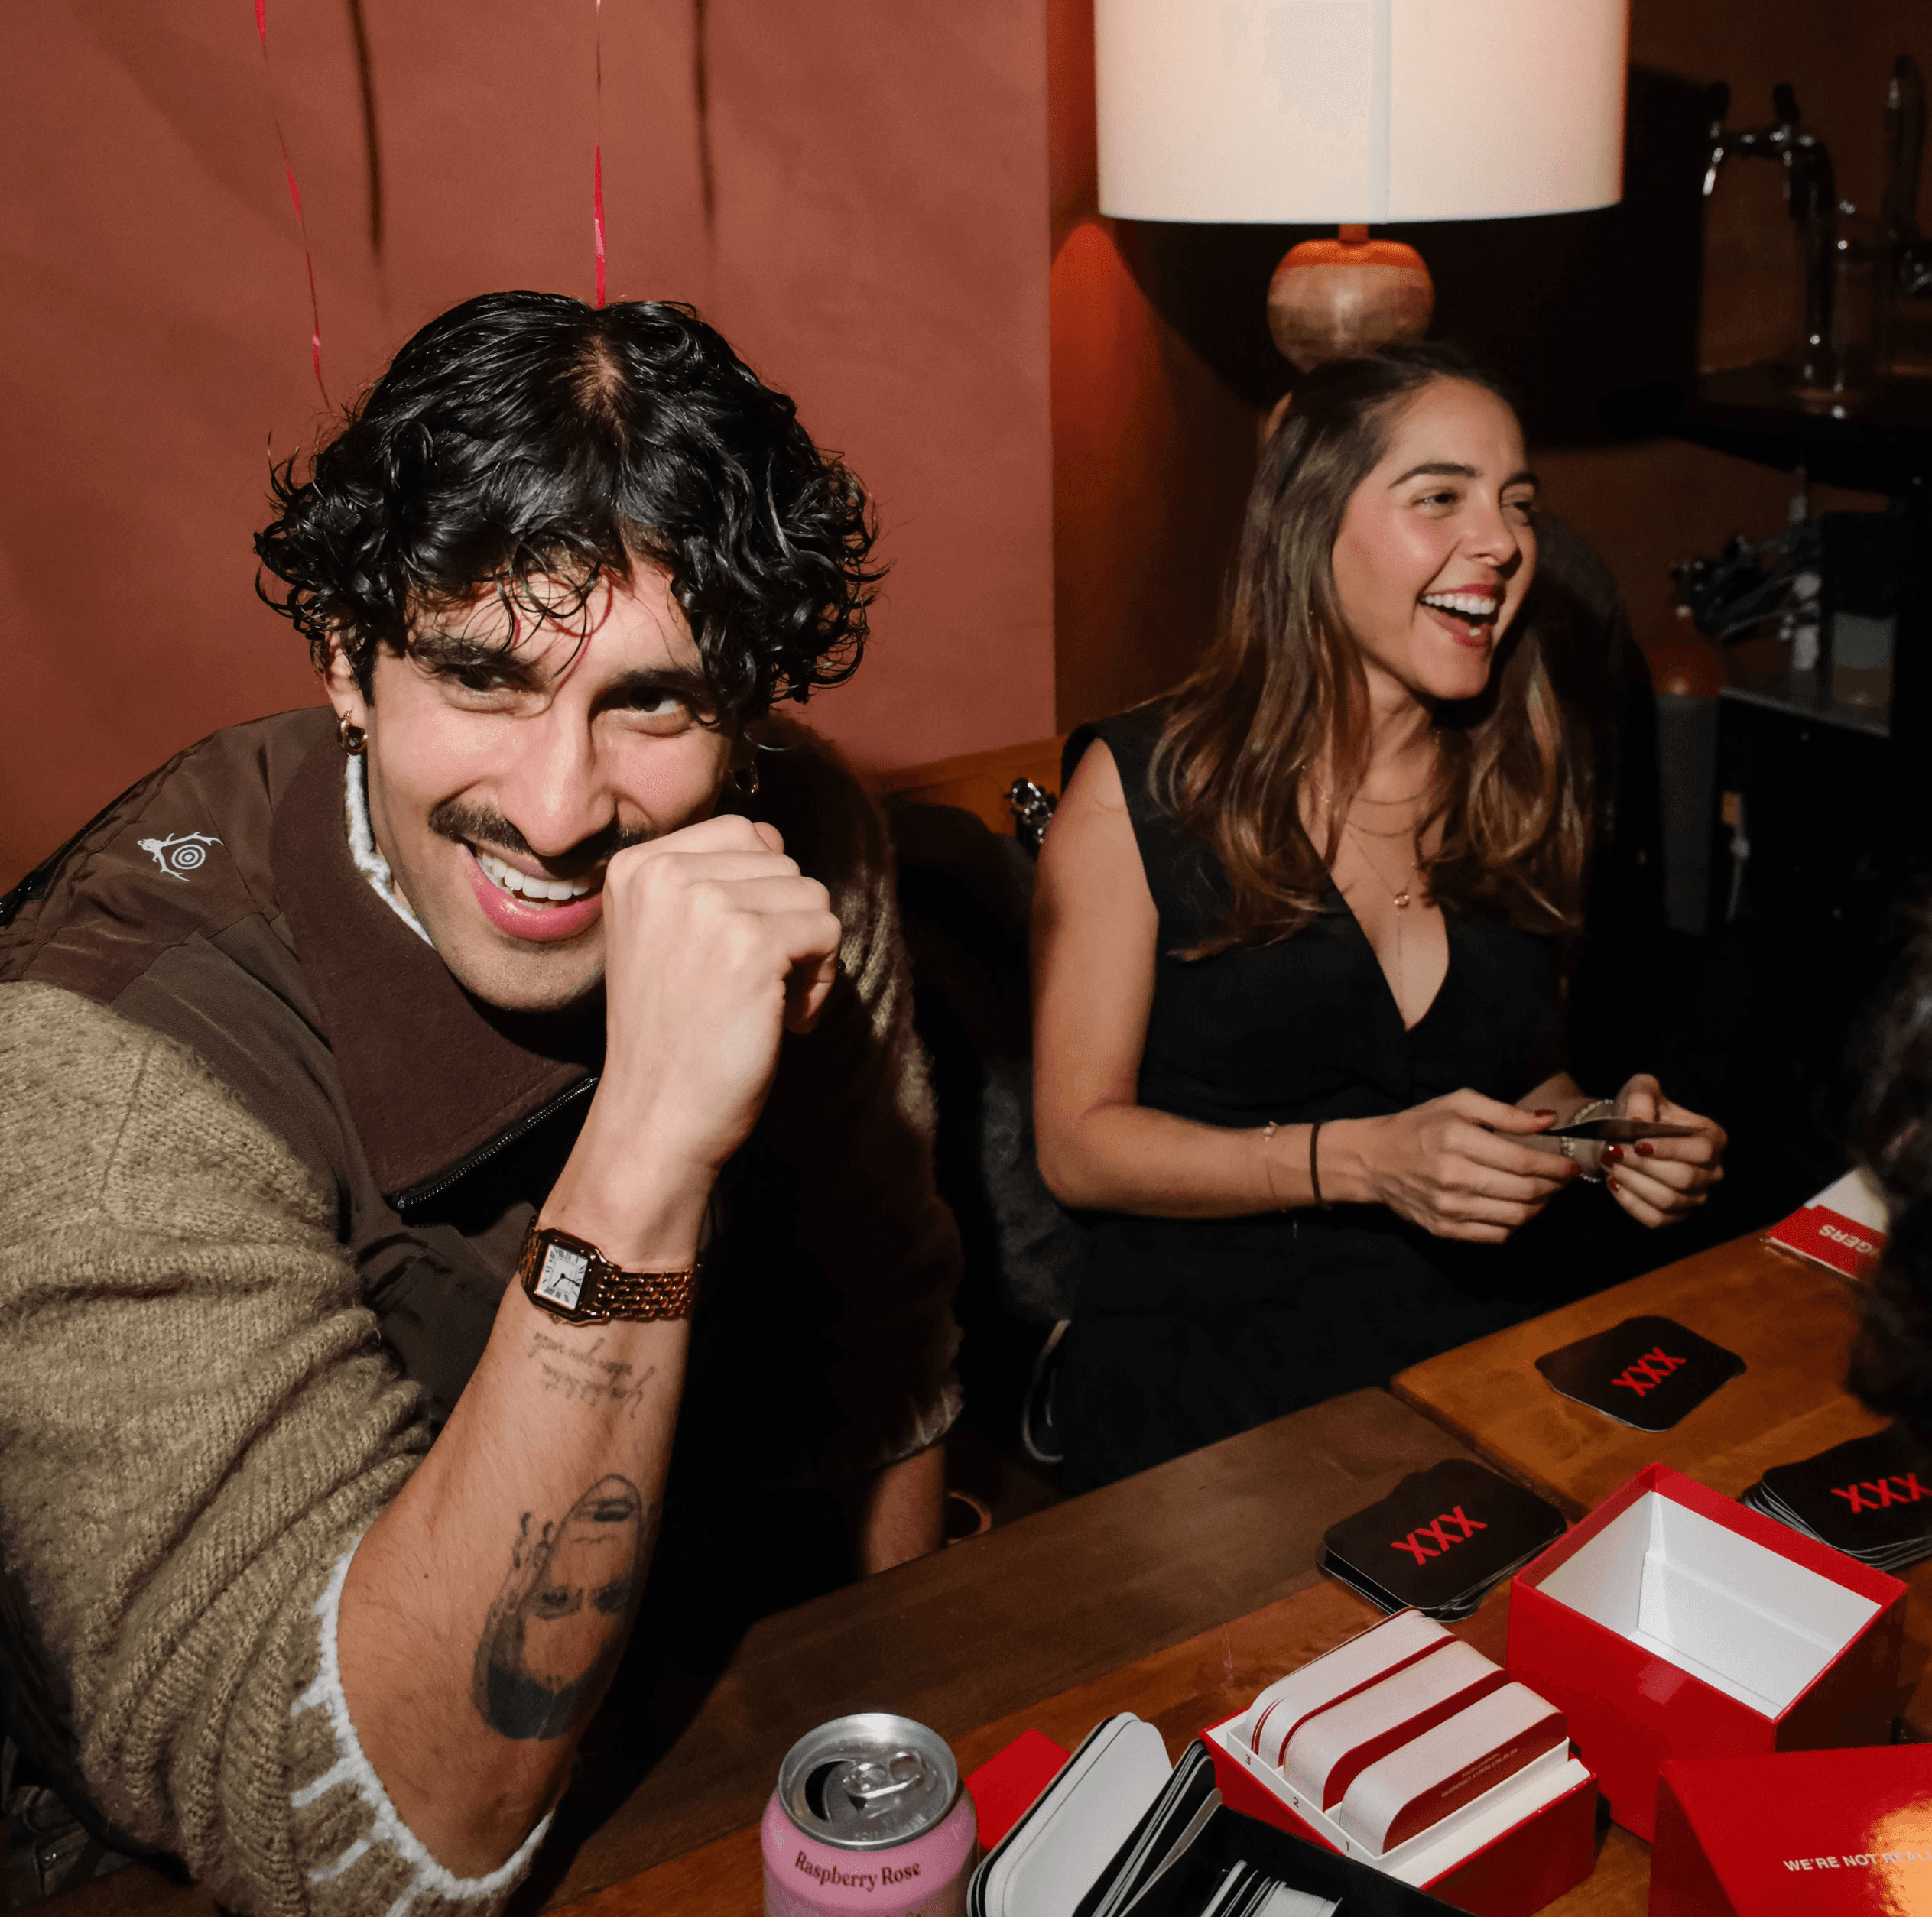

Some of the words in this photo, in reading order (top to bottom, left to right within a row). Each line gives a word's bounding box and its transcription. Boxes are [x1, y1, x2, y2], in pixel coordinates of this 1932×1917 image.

[1818, 1224, 1879, 1258] GERS
[1611, 1346, 1687, 1397] XXX
[1830, 1471, 1932, 1514] XXX
[1390, 1505, 1489, 1567] XXX
[1245, 1754, 1252, 1766] 3
[1293, 1796, 1300, 1808] 2
[1346, 1841, 1350, 1851] 1
[1783, 1856, 1841, 1872] WE'RE
[1841, 1853, 1877, 1867] NOT
[794, 1850, 878, 1893] Raspberry
[881, 1863, 921, 1886] Rose
